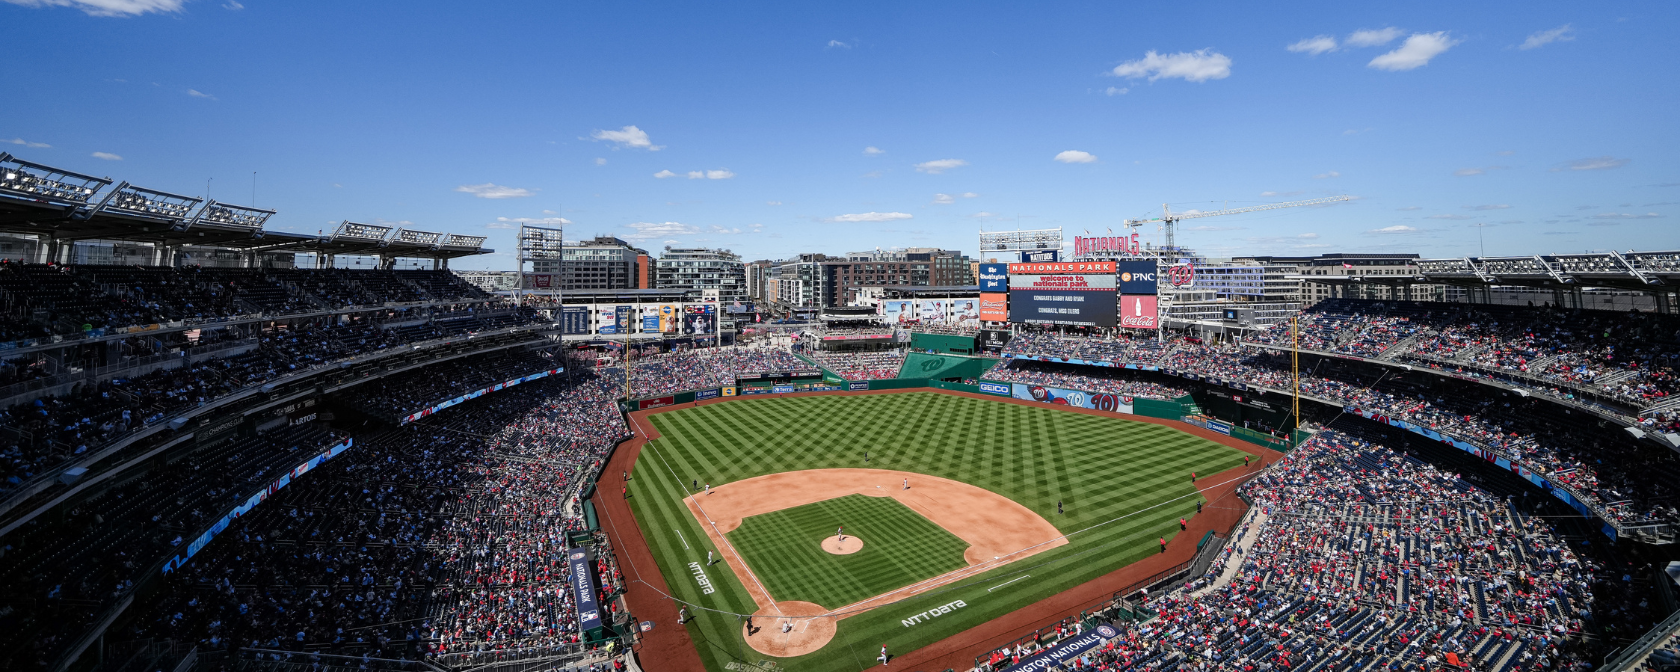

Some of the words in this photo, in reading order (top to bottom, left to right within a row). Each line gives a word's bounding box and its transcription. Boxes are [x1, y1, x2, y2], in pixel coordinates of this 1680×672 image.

[1075, 233, 1139, 256] NATIONALS
[1012, 264, 1074, 272] NATIONALS
[1079, 263, 1110, 271] PARK
[980, 273, 1006, 281] Washington
[1132, 273, 1155, 282] PNC
[980, 383, 1009, 393] GEICO
[687, 561, 705, 575] NTT
[575, 562, 589, 590] NATIONALS
[579, 588, 592, 604] PARK
[901, 611, 930, 628] NTT
[1049, 633, 1101, 660] NATIONALS
